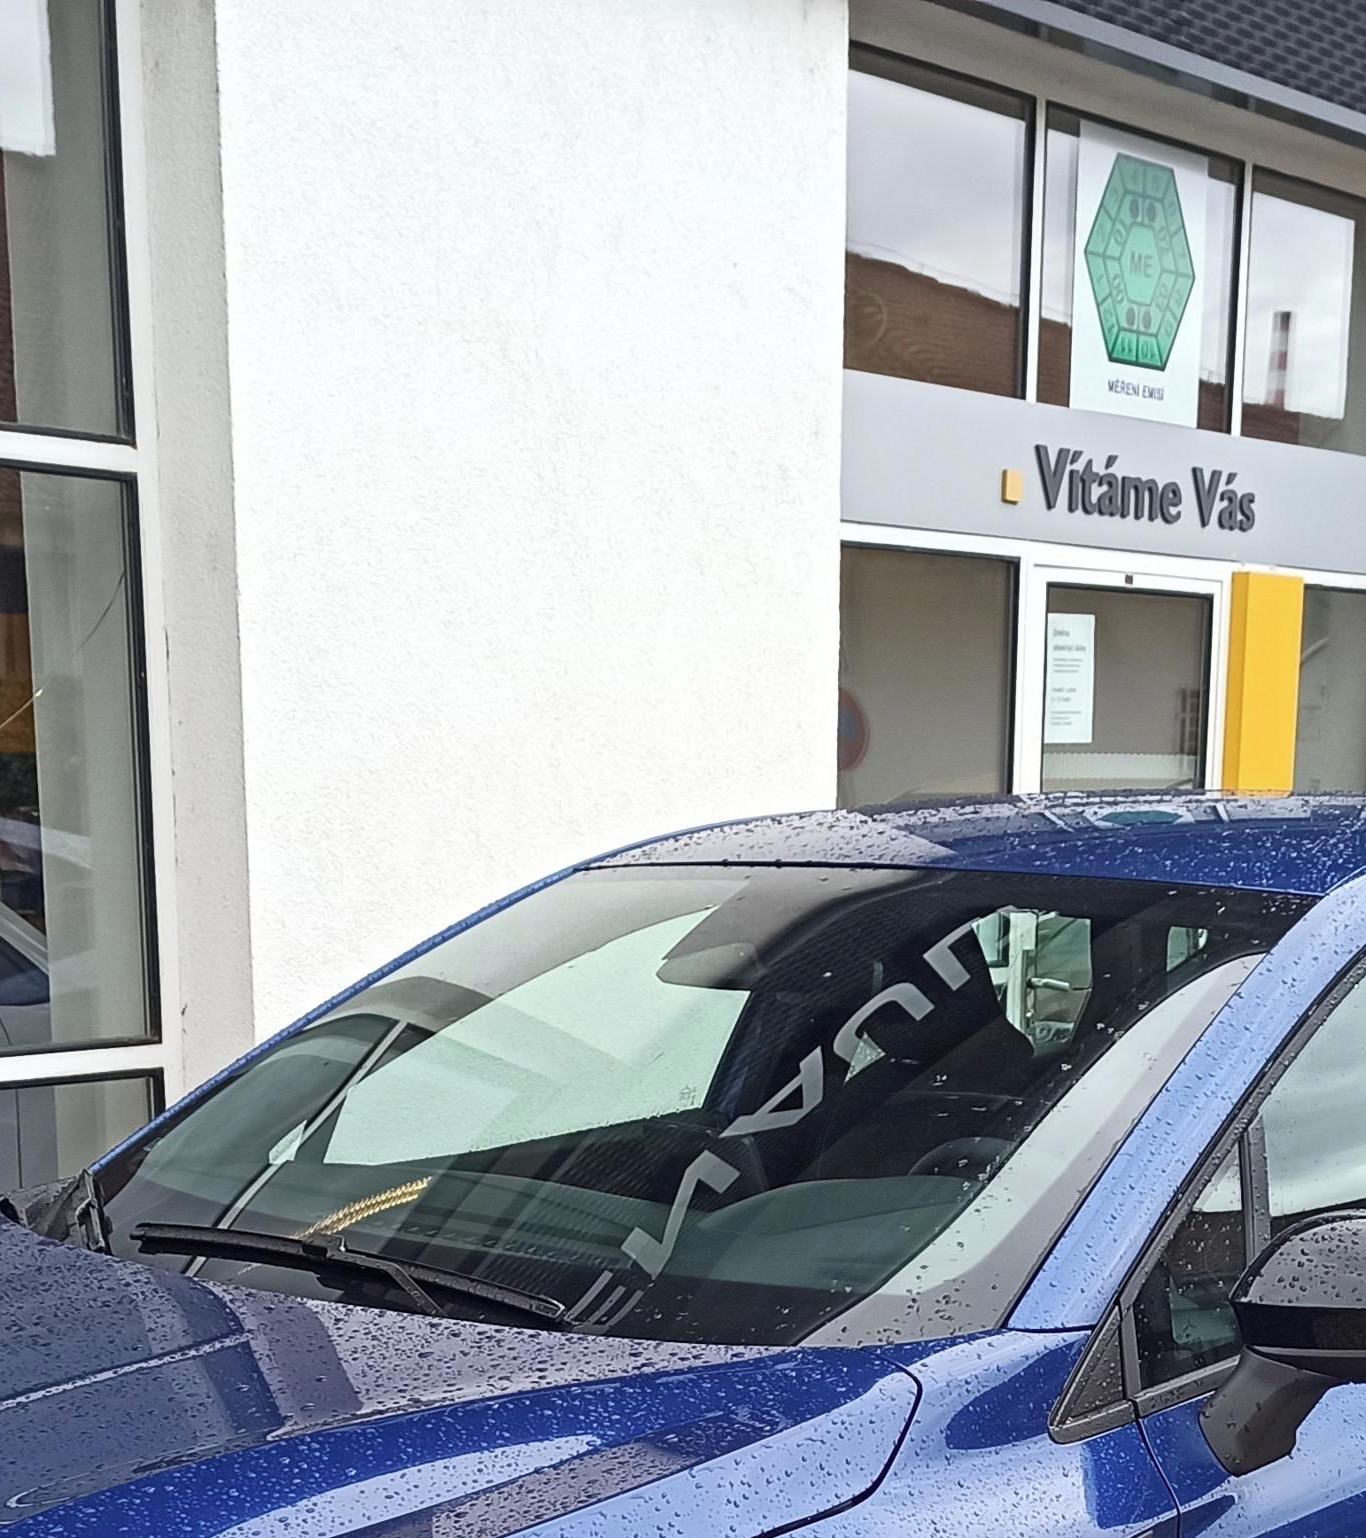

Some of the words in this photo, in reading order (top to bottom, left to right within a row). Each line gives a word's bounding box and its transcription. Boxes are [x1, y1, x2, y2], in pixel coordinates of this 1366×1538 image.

[1130, 253, 1153, 279] ME
[1034, 444, 1183, 525] Vítáme
[1191, 466, 1256, 532] Vás
